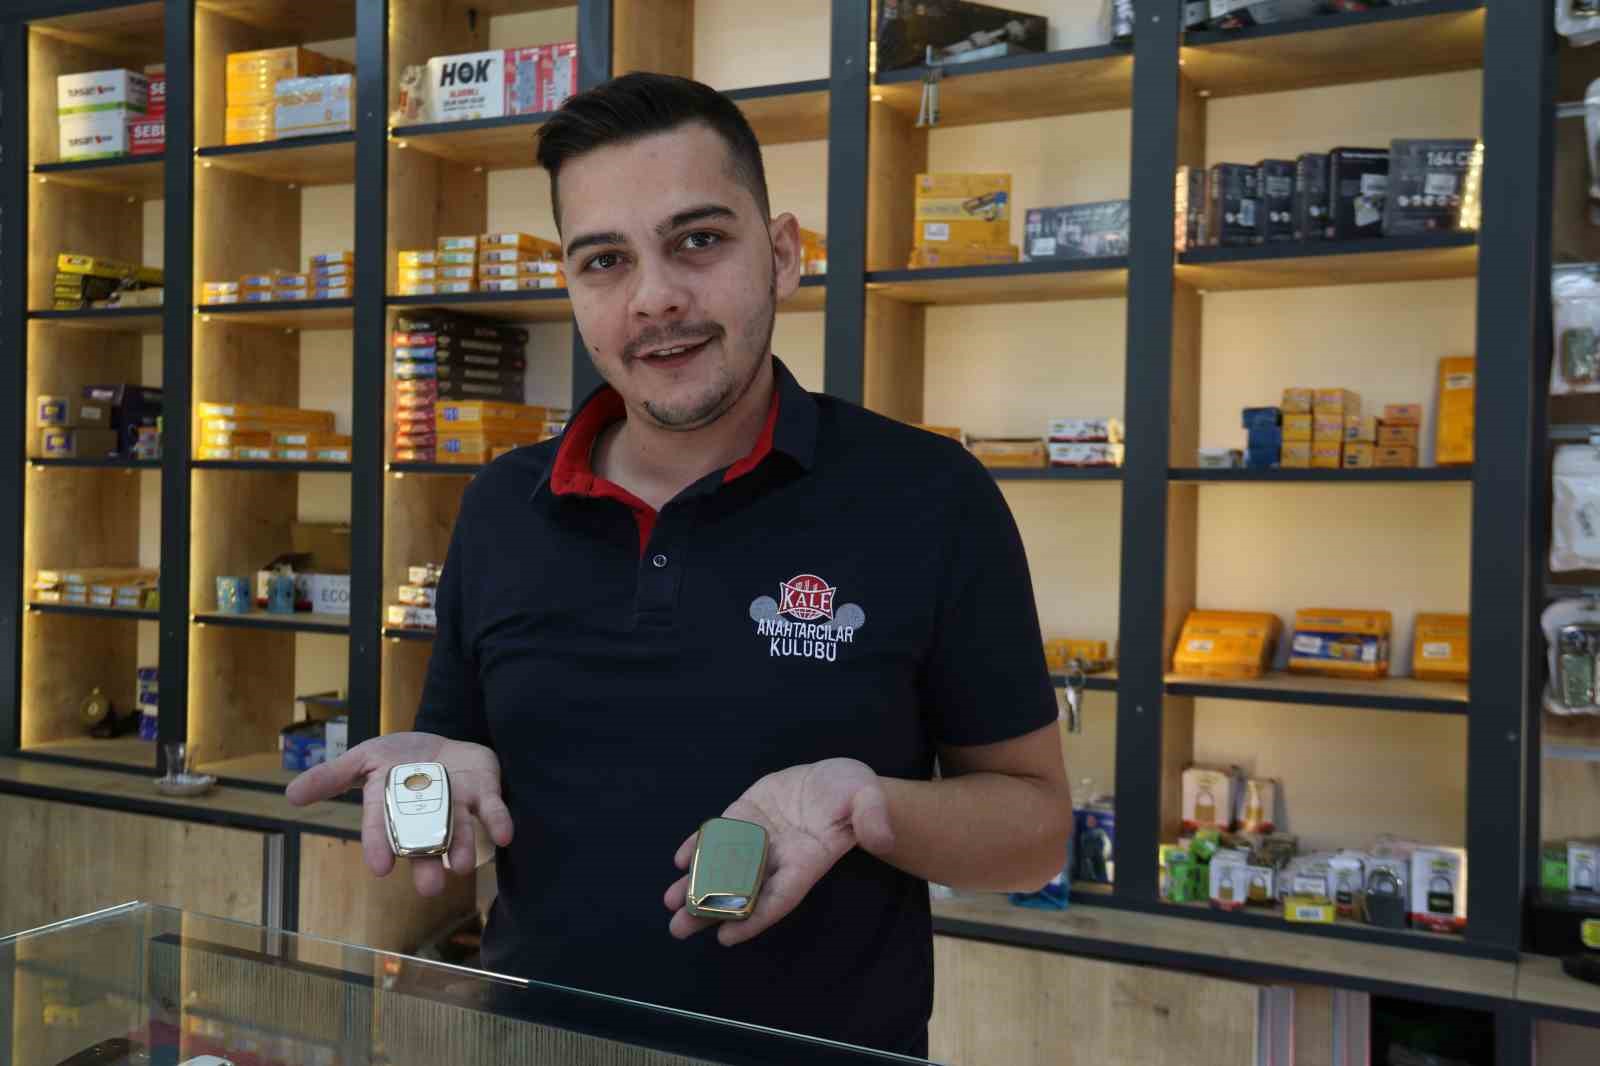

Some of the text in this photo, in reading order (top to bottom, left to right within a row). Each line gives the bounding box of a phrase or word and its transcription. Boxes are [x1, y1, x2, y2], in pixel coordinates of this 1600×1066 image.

[440, 59, 491, 88] HOK
[784, 588, 832, 612] KALE
[757, 618, 854, 643] ANAHTARCILAR
[770, 637, 837, 662] KULÜBÜ
